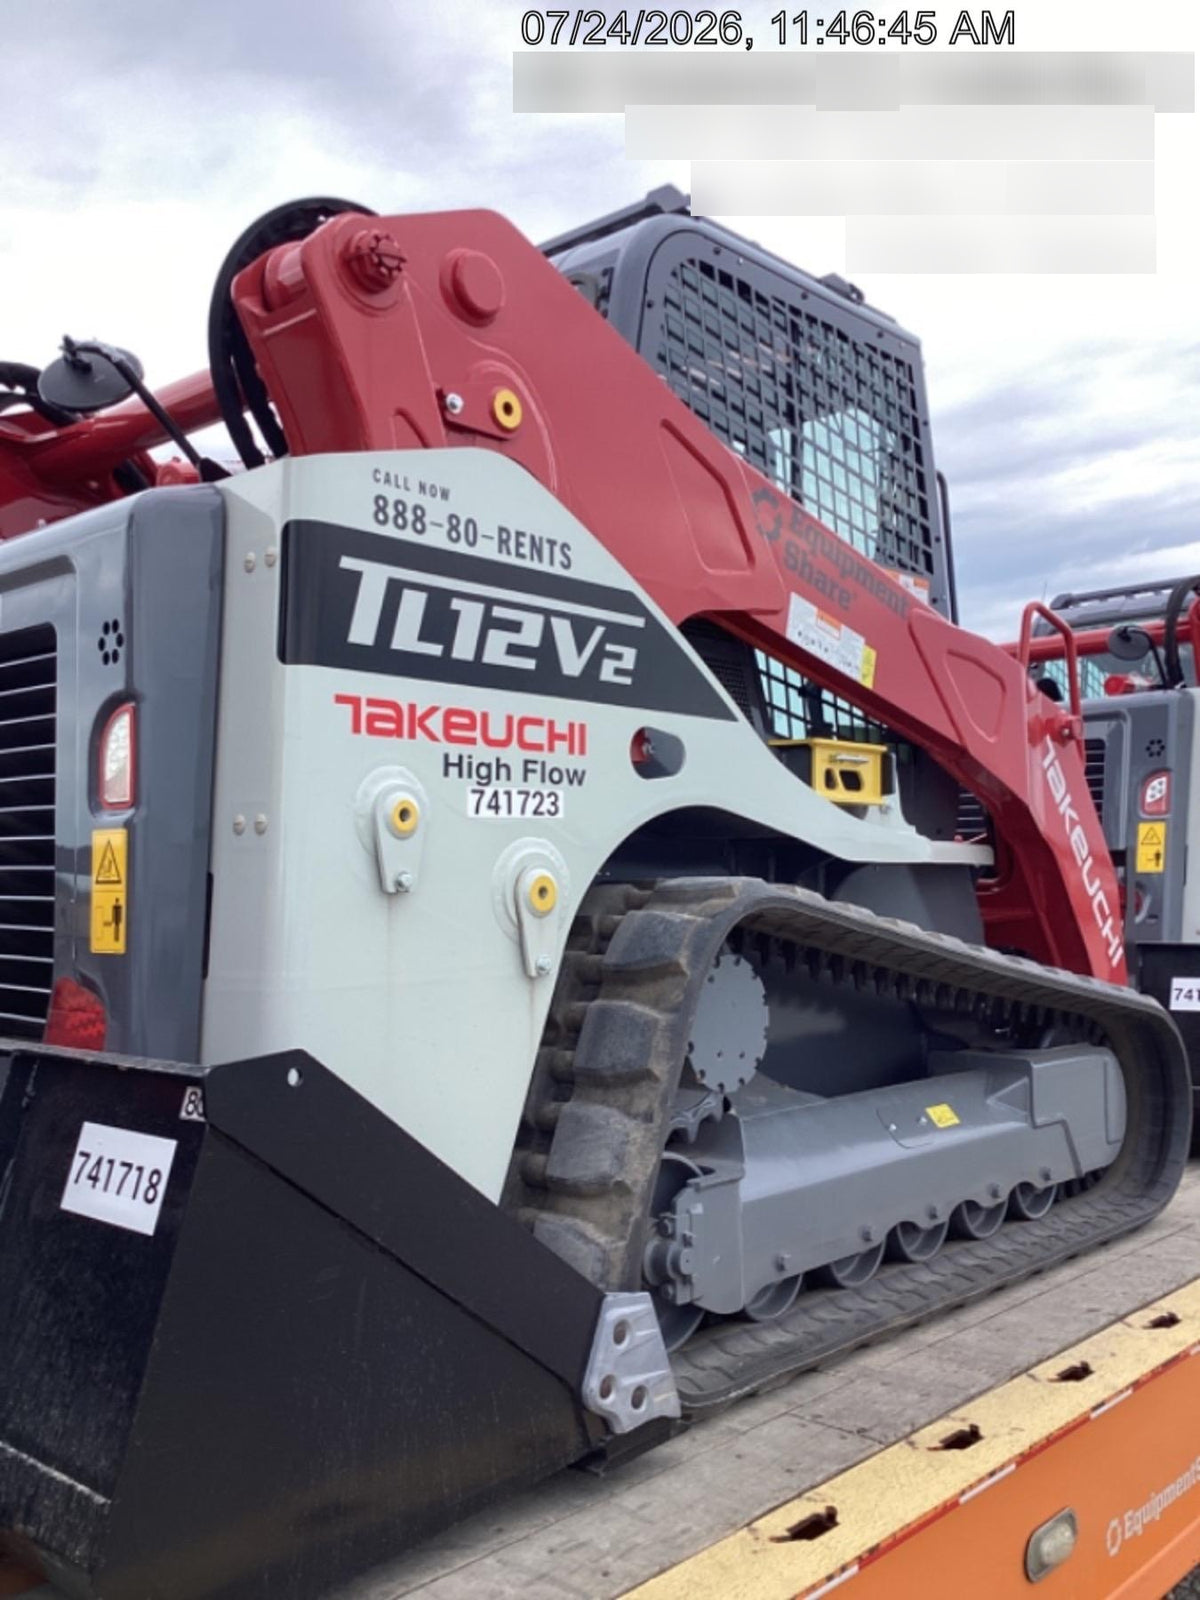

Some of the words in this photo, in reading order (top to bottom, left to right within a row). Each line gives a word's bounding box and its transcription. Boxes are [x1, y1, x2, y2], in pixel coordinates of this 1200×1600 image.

[372, 468, 411, 492] CALL
[418, 480, 451, 502] NOW
[372, 494, 573, 570] 888-80-RENTS
[788, 506, 910, 618] Equipment
[442, 753, 512, 788] High
[522, 759, 587, 787] Flow
[470, 789, 561, 817] 741723
[73, 1151, 162, 1205] 741718
